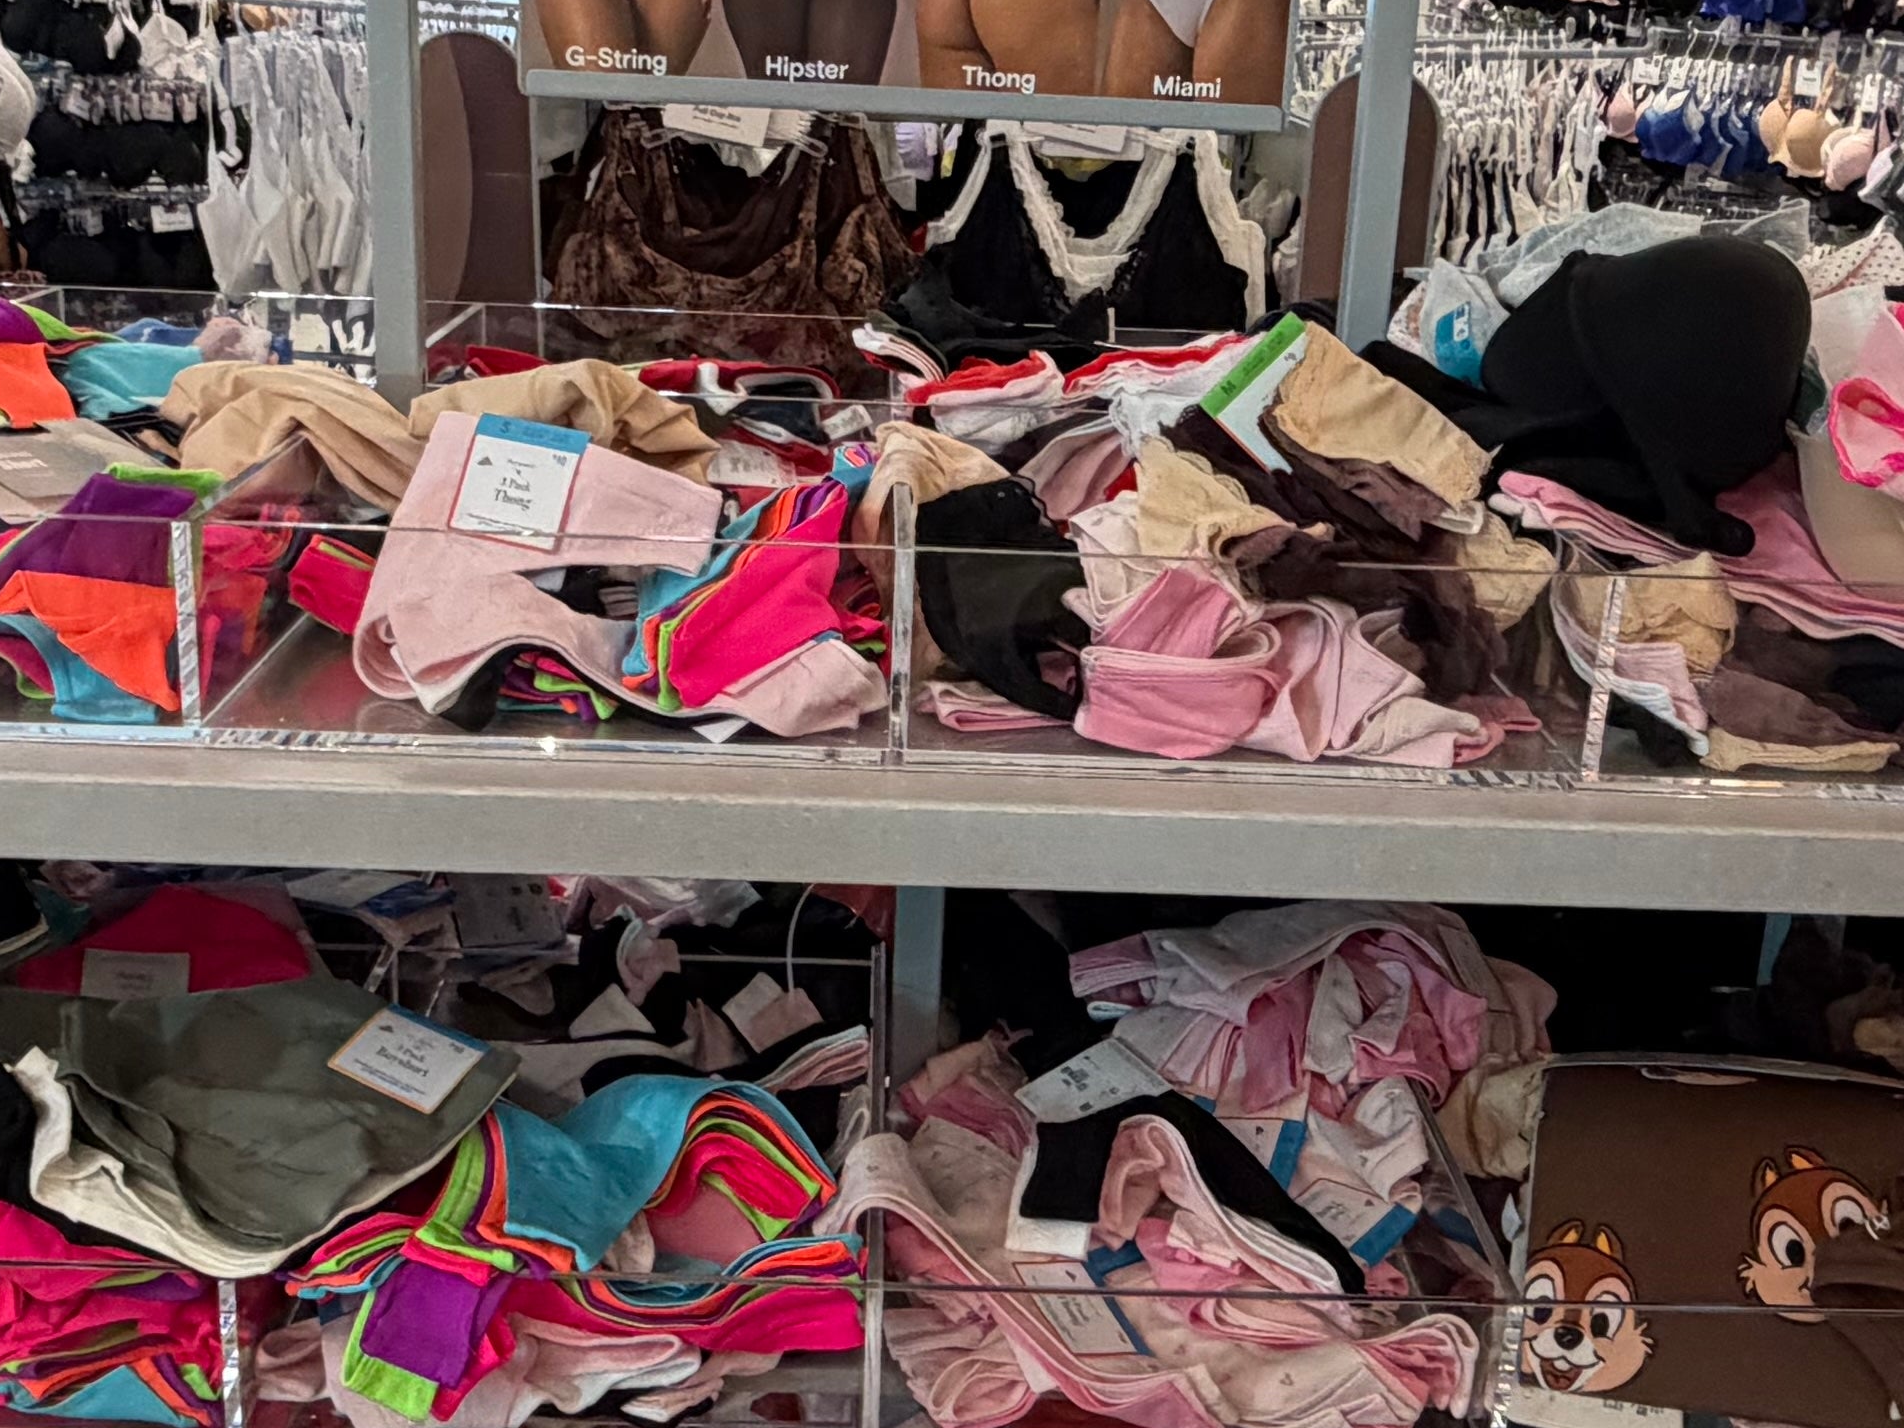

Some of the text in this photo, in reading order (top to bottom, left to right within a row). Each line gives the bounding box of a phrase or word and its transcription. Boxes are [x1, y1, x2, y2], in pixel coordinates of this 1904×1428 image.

[565, 47, 667, 76] G-String
[765, 55, 849, 85] Hipster
[963, 66, 1036, 94] Thong
[1153, 76, 1221, 100] Miami
